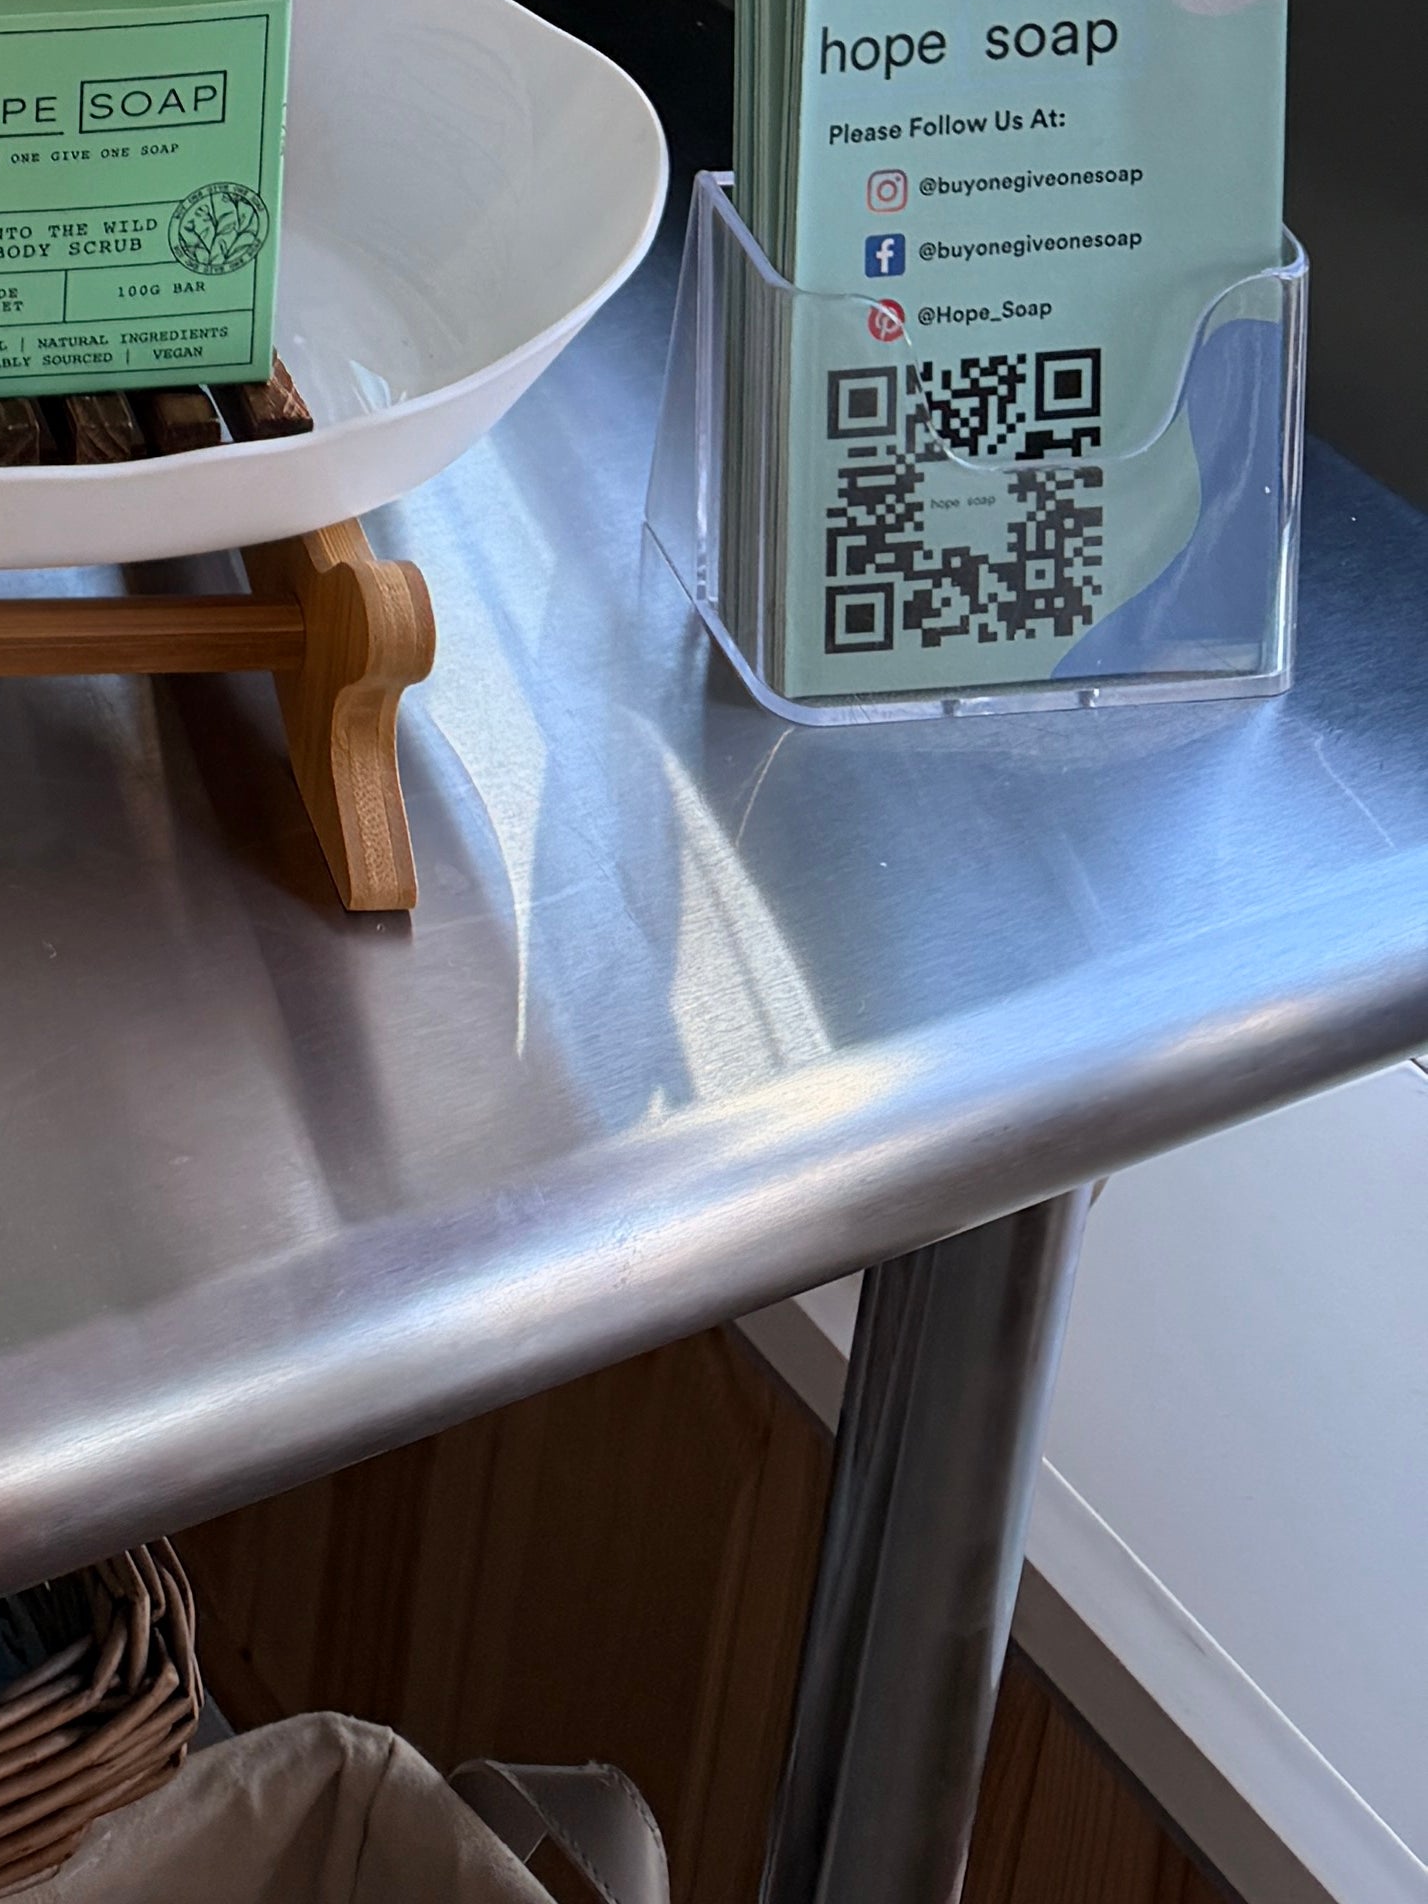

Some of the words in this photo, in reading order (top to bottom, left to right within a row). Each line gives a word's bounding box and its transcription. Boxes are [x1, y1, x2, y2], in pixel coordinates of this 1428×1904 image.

[819, 27, 947, 81] hope
[985, 17, 1118, 66] soap
[89, 85, 218, 120] SOAP
[829, 124, 902, 145] Please
[909, 116, 988, 137] Follow
[995, 110, 1024, 131] Us
[1030, 108, 1066, 129] At:
[11, 152, 40, 163] ONE
[50, 149, 90, 161] GIVE
[100, 146, 130, 158] ONE
[140, 143, 179, 155] SOAP
[919, 166, 1144, 198] @buyonegiveonesoap
[48, 223, 88, 238] THE
[103, 218, 159, 234] WILD
[69, 238, 143, 256] SCRUB
[919, 230, 1143, 262] @buyonegiveonesoap
[118, 284, 161, 298] 100G
[173, 281, 207, 294] BAR
[918, 301, 1053, 327] @Hope_Soap
[37, 335, 109, 350] NATURAL
[120, 327, 228, 344] INGREDIENTS
[42, 351, 113, 366] SOURCED
[153, 347, 203, 360] VEGAN
